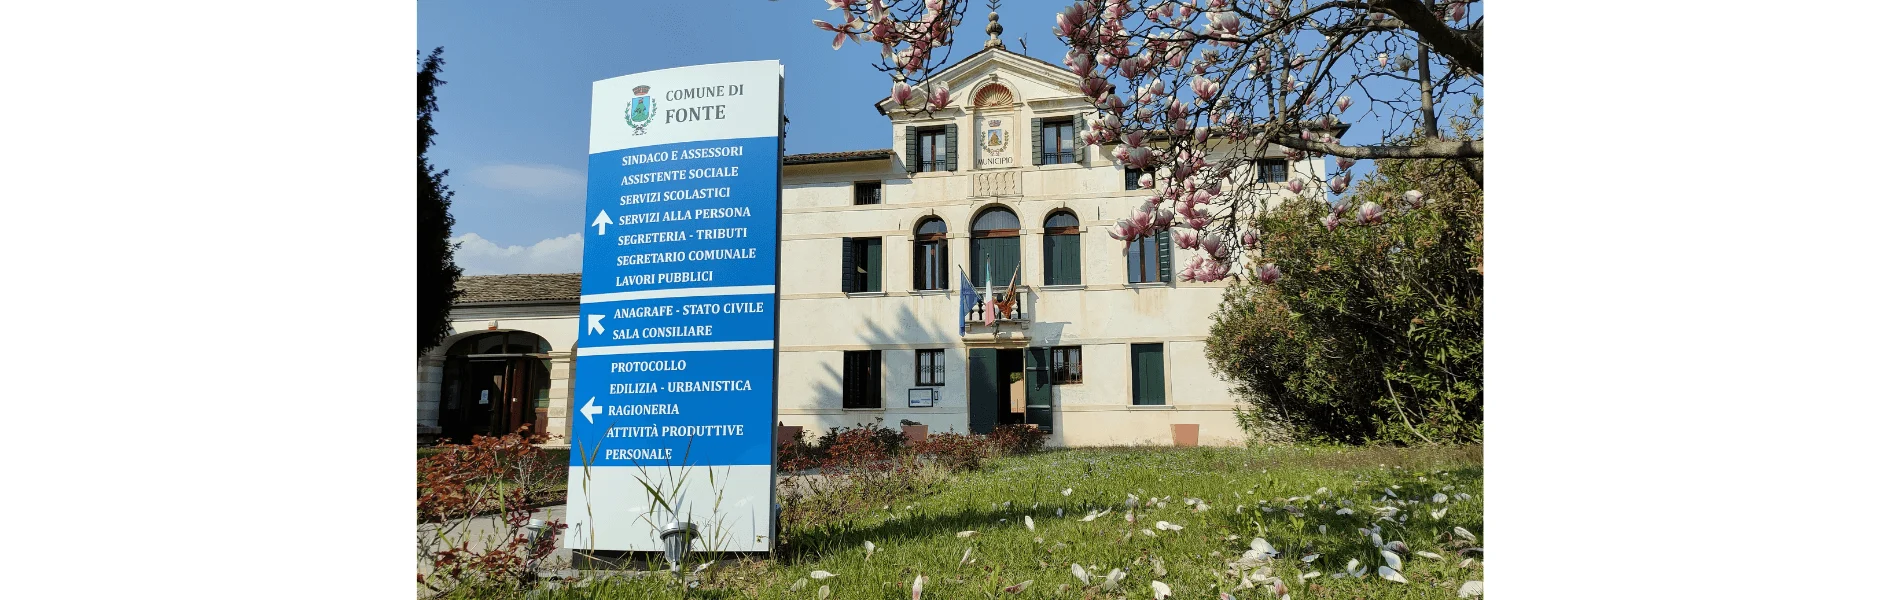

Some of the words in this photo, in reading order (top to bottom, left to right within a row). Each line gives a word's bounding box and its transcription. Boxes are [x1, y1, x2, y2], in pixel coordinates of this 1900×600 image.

[666, 86, 724, 101] COMUNE
[728, 84, 744, 96] DI
[665, 104, 726, 124] FONTE
[622, 150, 669, 166] SINDACO
[671, 149, 678, 161] E
[680, 146, 743, 160] ASSESSORI
[978, 157, 1013, 165] MUNICIPIO
[621, 170, 686, 186] ASSISTENTE
[688, 166, 739, 179] SOCIALE
[620, 191, 661, 206] SERVIZI
[663, 187, 731, 201] SCOLASTICI
[619, 211, 660, 226] SERVIZI
[662, 209, 692, 222] ALLA
[695, 206, 751, 220] PERSONA
[618, 231, 686, 246] SEGRETERIA
[696, 227, 748, 240] TRIBUTI
[616, 251, 686, 267] SEGRETARIO
[688, 248, 757, 261] COMUNALE
[616, 273, 655, 287] LAVORI
[658, 270, 713, 284] PUBBLICI
[613, 306, 673, 319] ANAGRAFE
[682, 303, 721, 316] STATO
[723, 302, 764, 314] CIVILE
[612, 328, 640, 340] SALA
[642, 325, 713, 338] CONSILIARE
[610, 359, 687, 373] PROTOCOLLO
[609, 382, 658, 395] EDILIZIA
[667, 379, 752, 393] URBANISTICA
[608, 404, 680, 416] RAGIONERIA
[606, 423, 659, 438] ATTIVITÀ
[661, 424, 744, 437] PRODUTTIVE
[605, 448, 672, 460] PERSONALE
